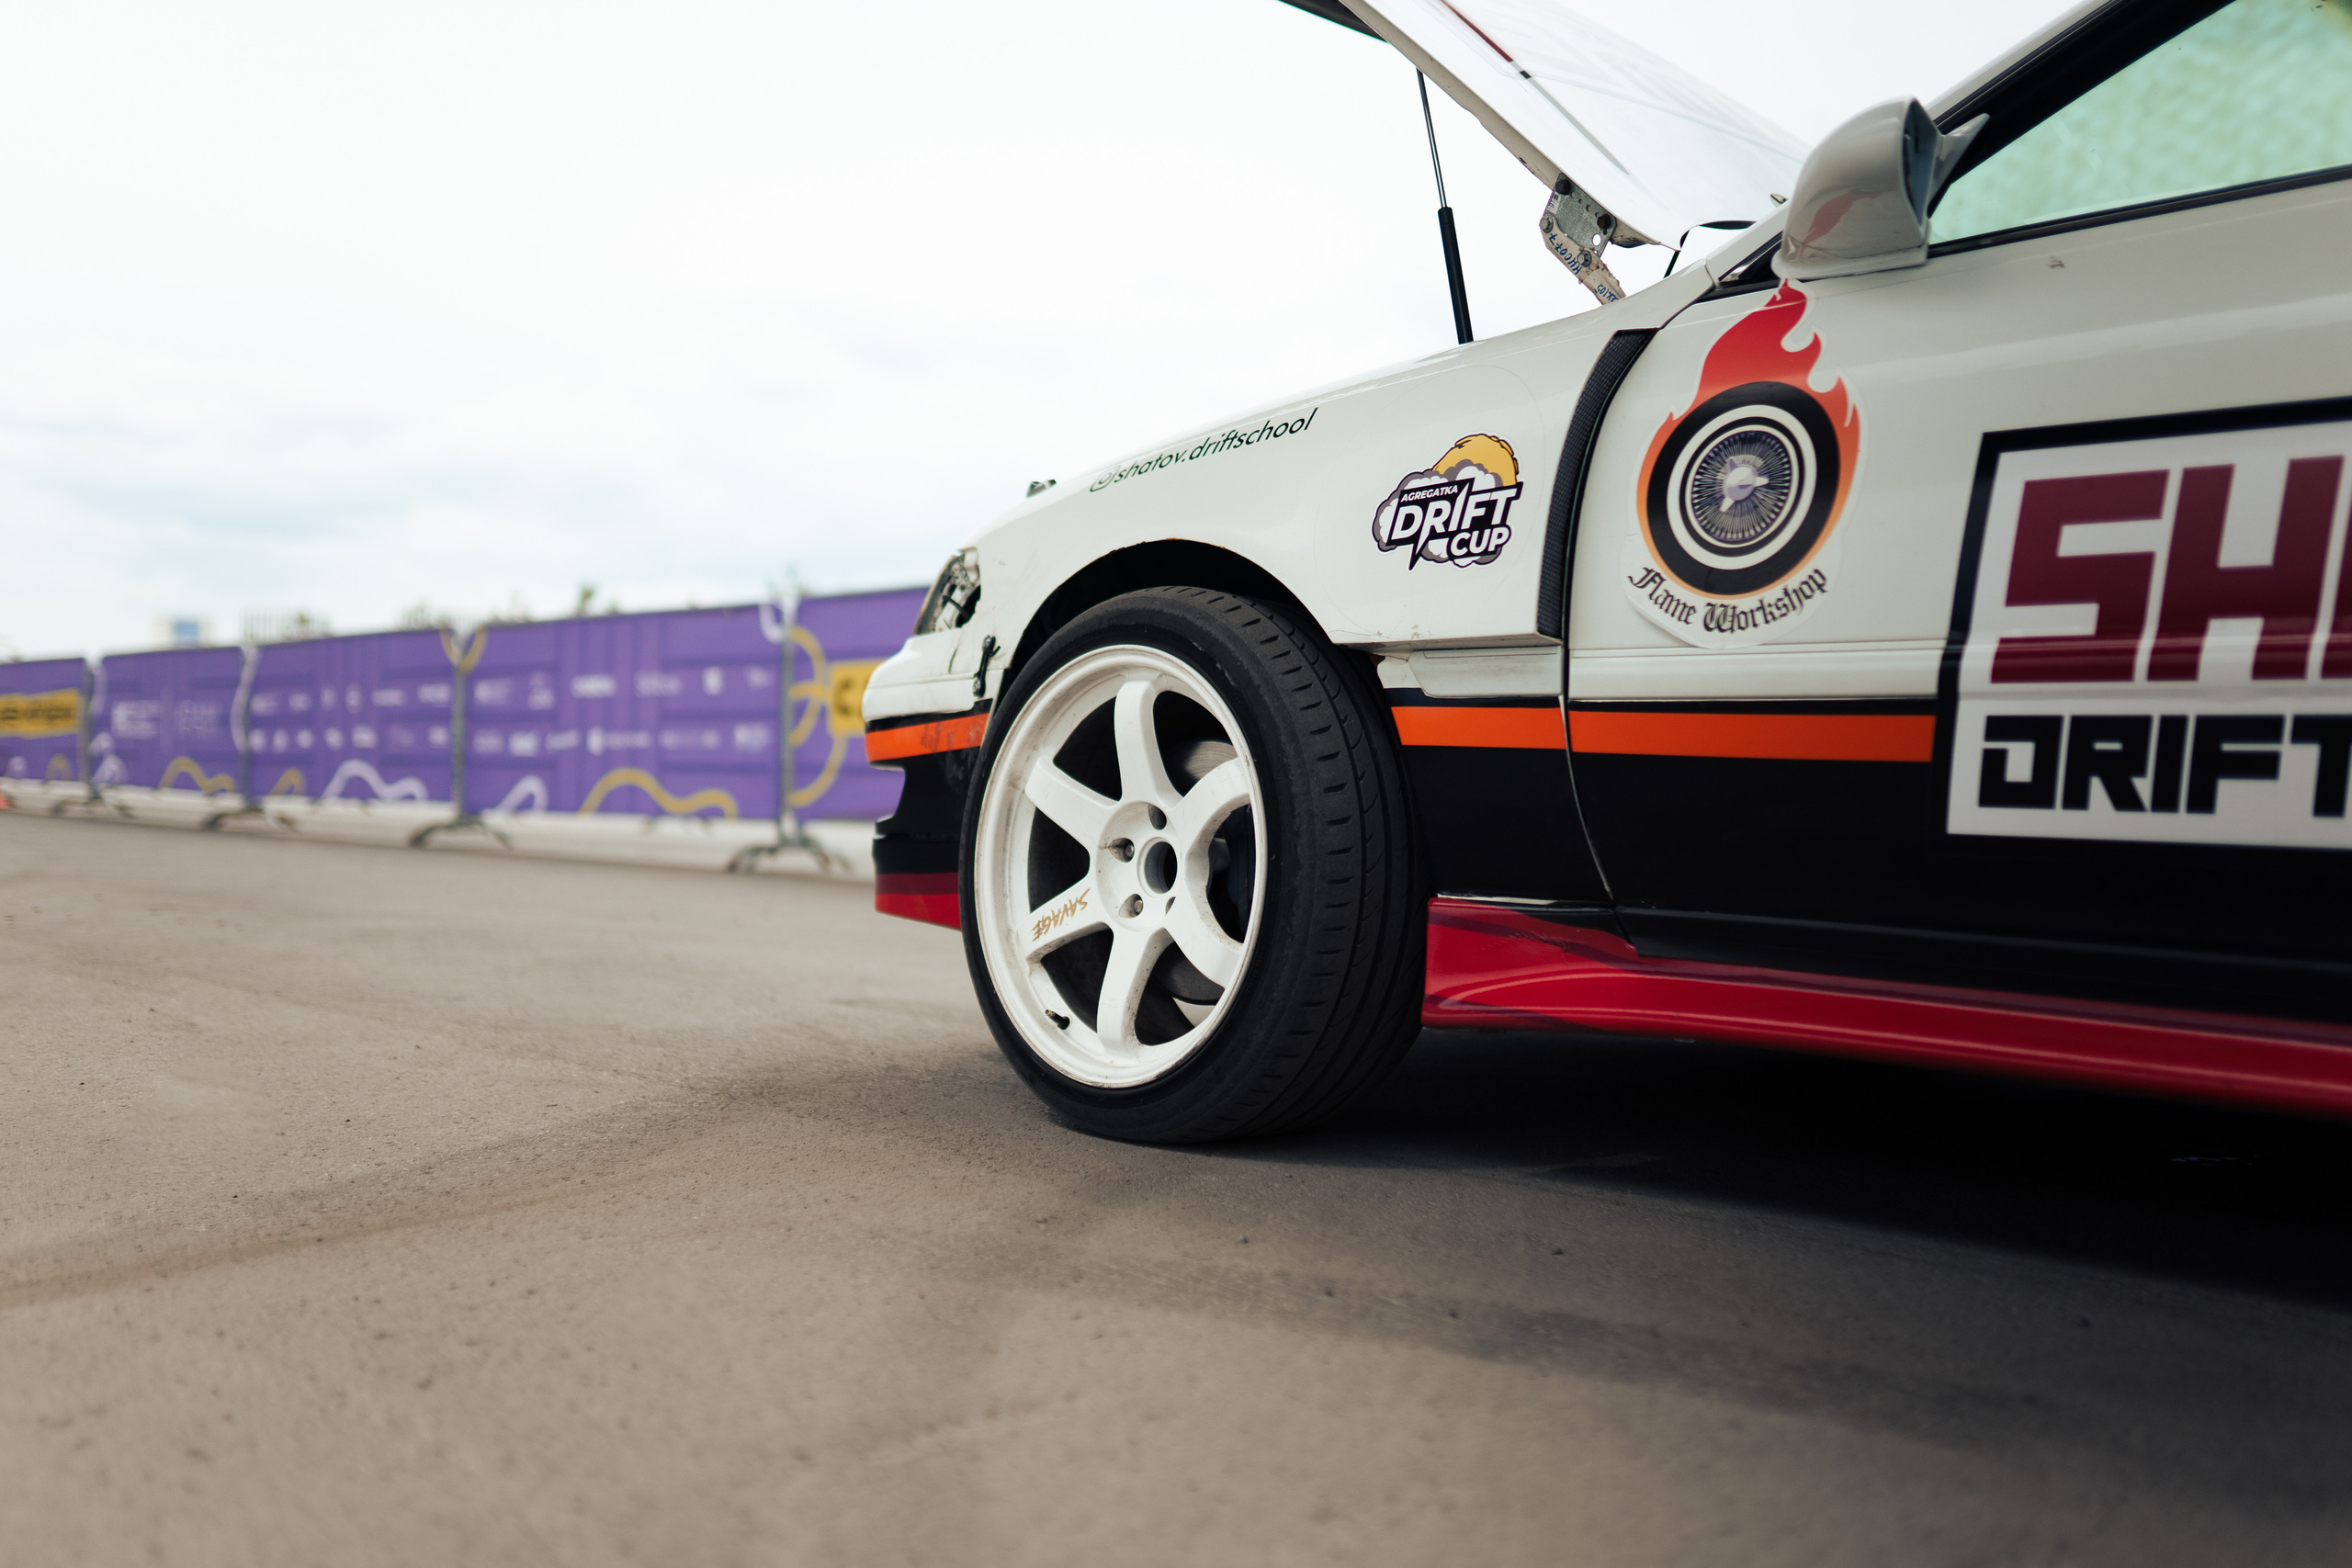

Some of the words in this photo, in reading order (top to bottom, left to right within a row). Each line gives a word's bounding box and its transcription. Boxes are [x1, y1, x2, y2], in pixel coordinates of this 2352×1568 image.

[1390, 482, 1518, 555] DRIFT
[1399, 484, 1459, 503] AGREGATKA
[1450, 526, 1510, 557] CUP
[1990, 454, 2352, 684] SH
[1627, 567, 1697, 626] Flame
[1702, 568, 1829, 634] Workshop
[1978, 714, 2352, 818] DRIFT
[1031, 887, 1091, 942] SAVAGE
